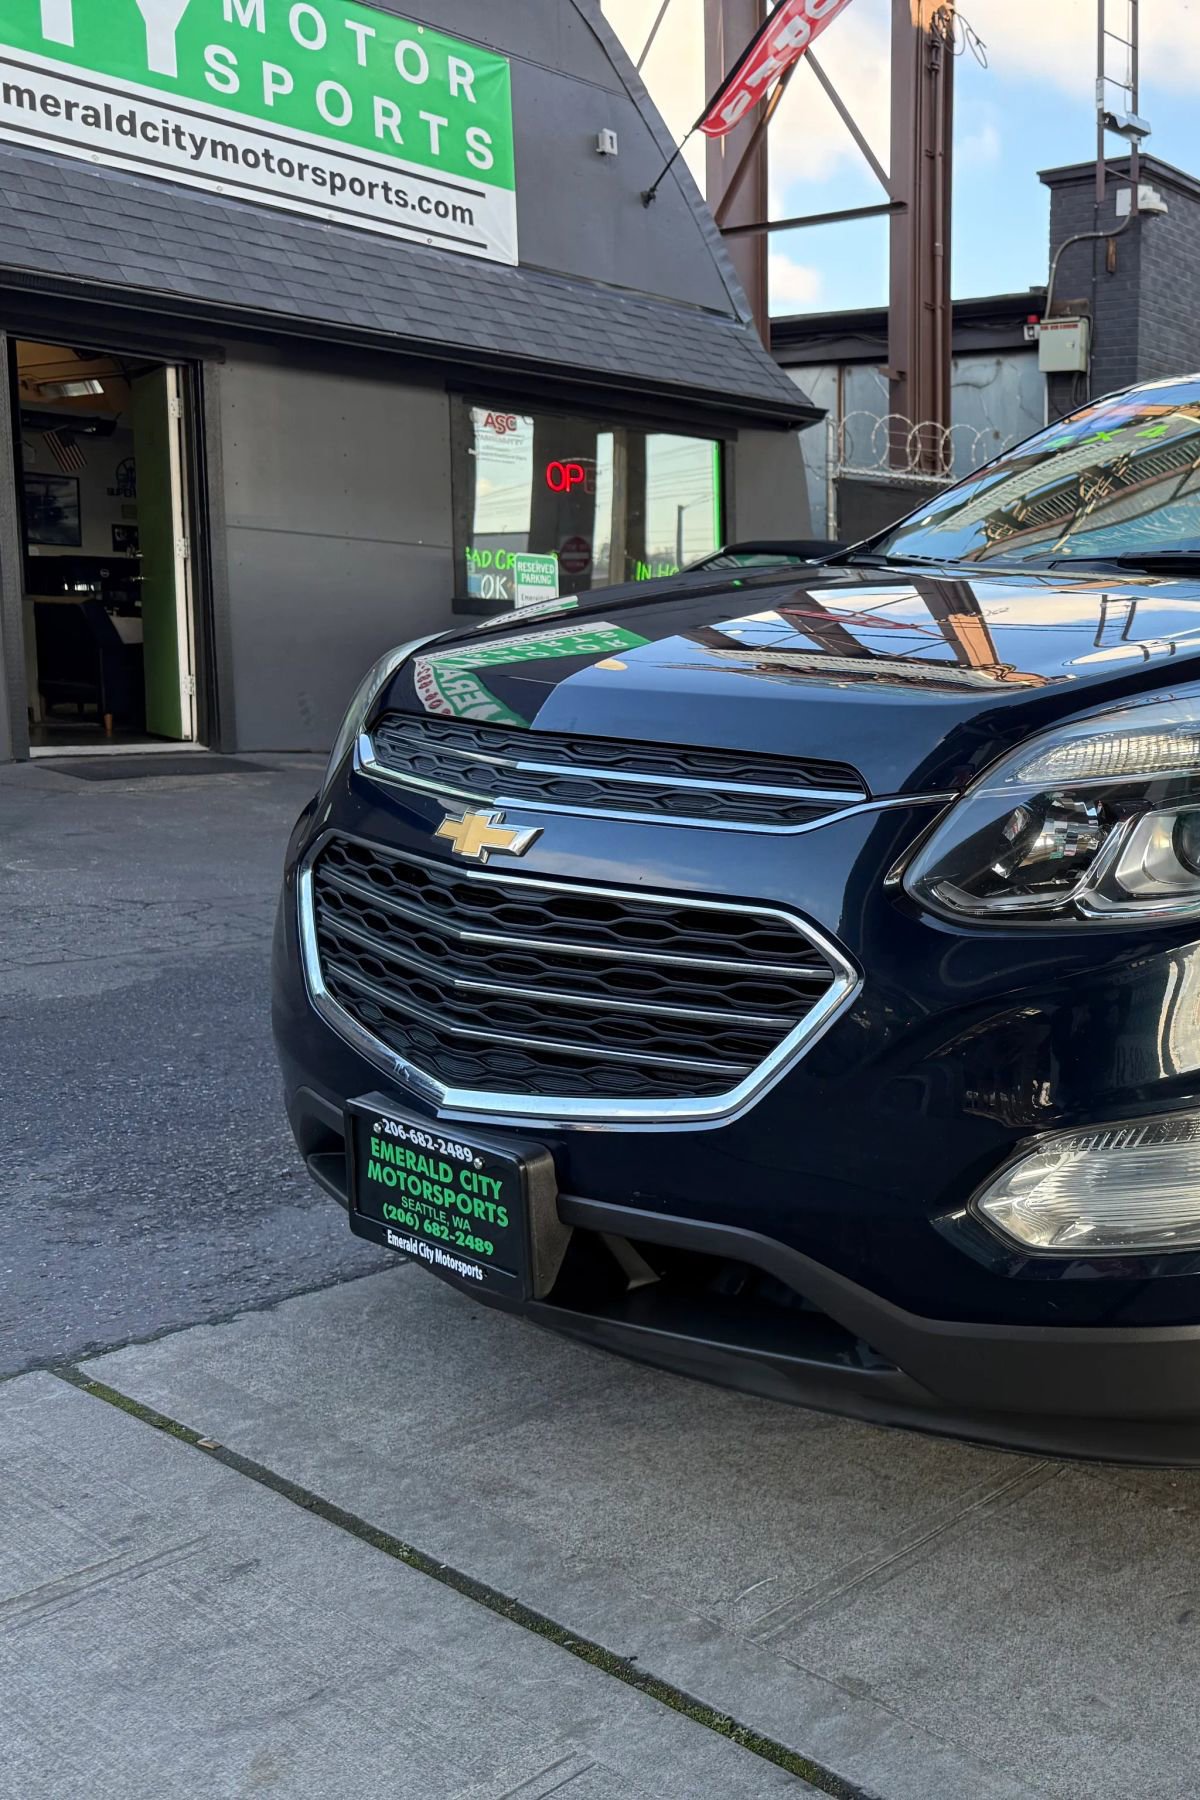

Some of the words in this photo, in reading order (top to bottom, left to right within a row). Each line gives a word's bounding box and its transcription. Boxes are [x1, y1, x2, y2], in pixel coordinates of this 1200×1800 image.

[222, 0, 477, 104] MOTOR
[204, 44, 495, 170] SPORTS
[480, 574, 509, 600] OK
[518, 560, 555, 575] RESERVED
[521, 573, 552, 585] PARKING
[636, 560, 652, 581] IN
[383, 1118, 473, 1163] 206-682-2489
[370, 1136, 453, 1184] EMERALD
[459, 1170, 503, 1200] CITY
[367, 1159, 509, 1228] MOTORSPORTS
[401, 1196, 450, 1227] SEATTLE,
[452, 1215, 471, 1232] WA
[382, 1202, 420, 1230] (206)
[423, 1220, 494, 1256] 682-2489
[387, 1230, 418, 1254] Emerald
[418, 1241, 434, 1264] City
[435, 1249, 483, 1280] Motorsports
